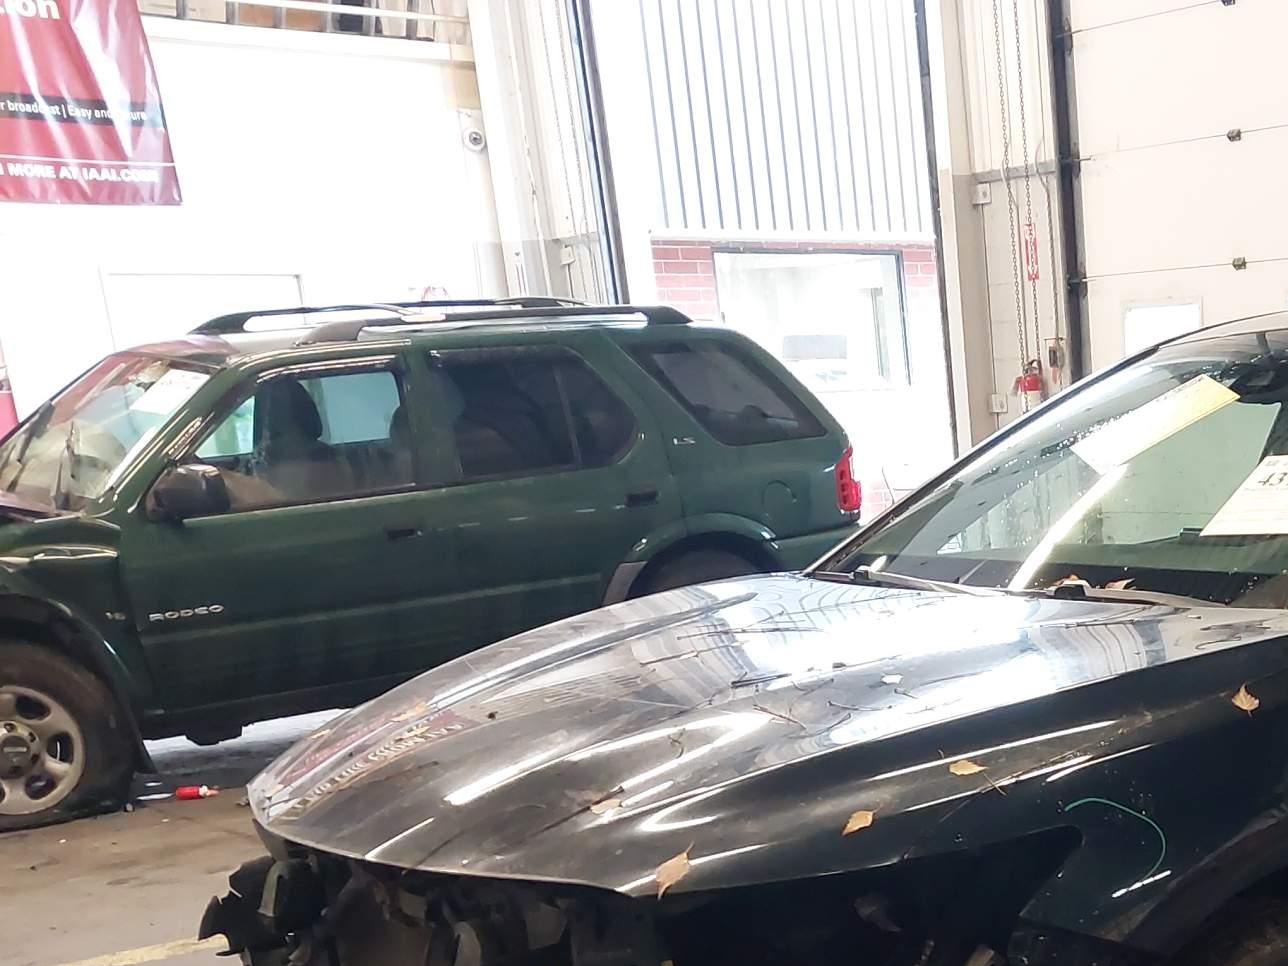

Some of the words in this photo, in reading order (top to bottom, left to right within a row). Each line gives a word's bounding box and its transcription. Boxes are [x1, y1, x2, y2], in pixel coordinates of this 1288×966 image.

[0, 0, 61, 19] ion
[67, 105, 92, 120] Easy
[6, 163, 57, 179] MORE
[59, 166, 80, 181] AT
[148, 604, 225, 622] RODEO
